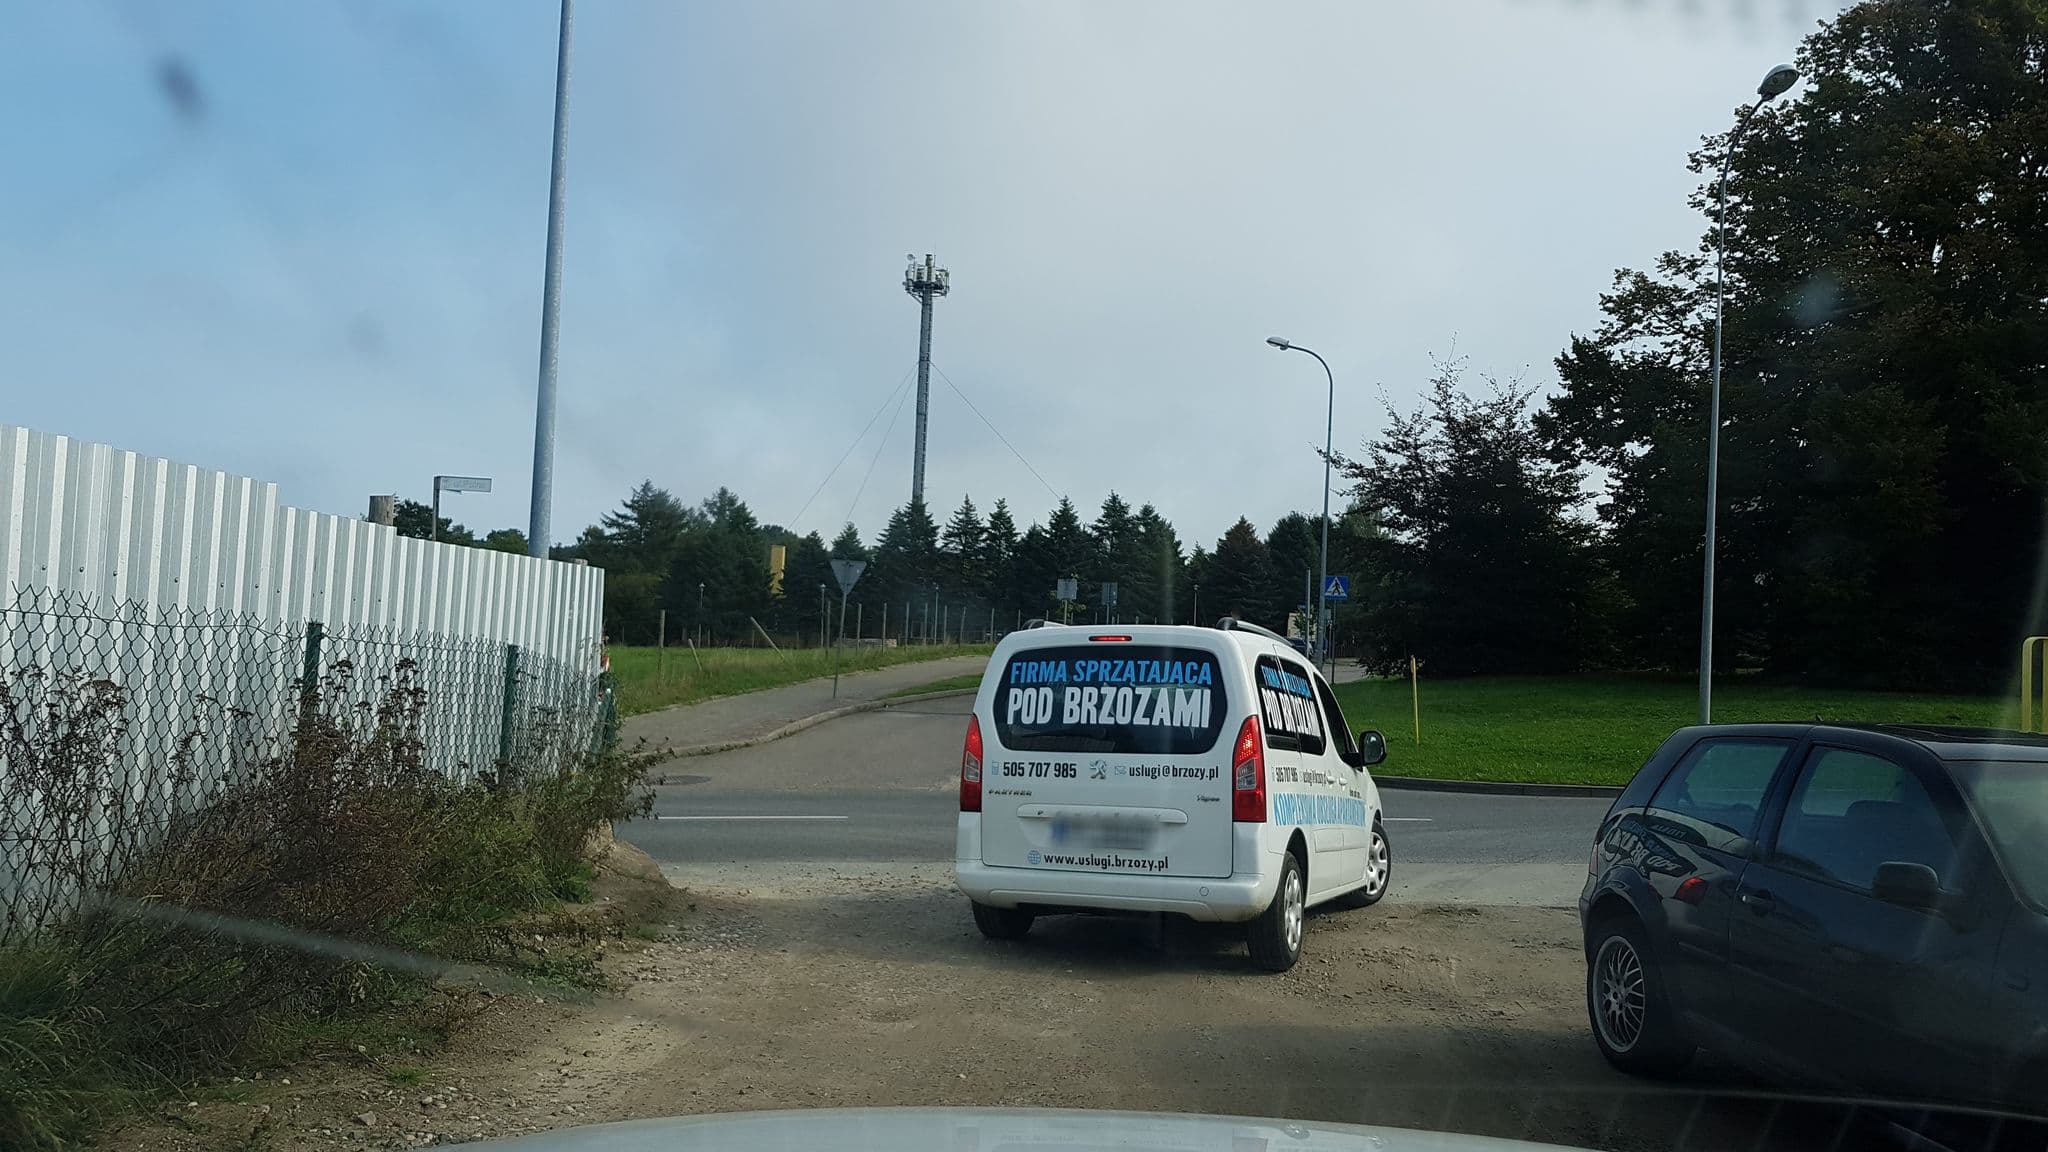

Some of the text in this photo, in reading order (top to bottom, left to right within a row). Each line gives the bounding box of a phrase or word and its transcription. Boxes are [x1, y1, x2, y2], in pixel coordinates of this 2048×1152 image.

[1010, 660, 1212, 687] FIRMA SPRZĄTAJĄCA
[1007, 686, 1211, 728] POD BRZOZAMI
[1261, 687, 1283, 730] POD
[1003, 761, 1077, 779] 505 707 985
[1129, 764, 1219, 781] uslugi@brzozy.pl
[1044, 853, 1169, 870] www.uslugi.brzozy.pl
